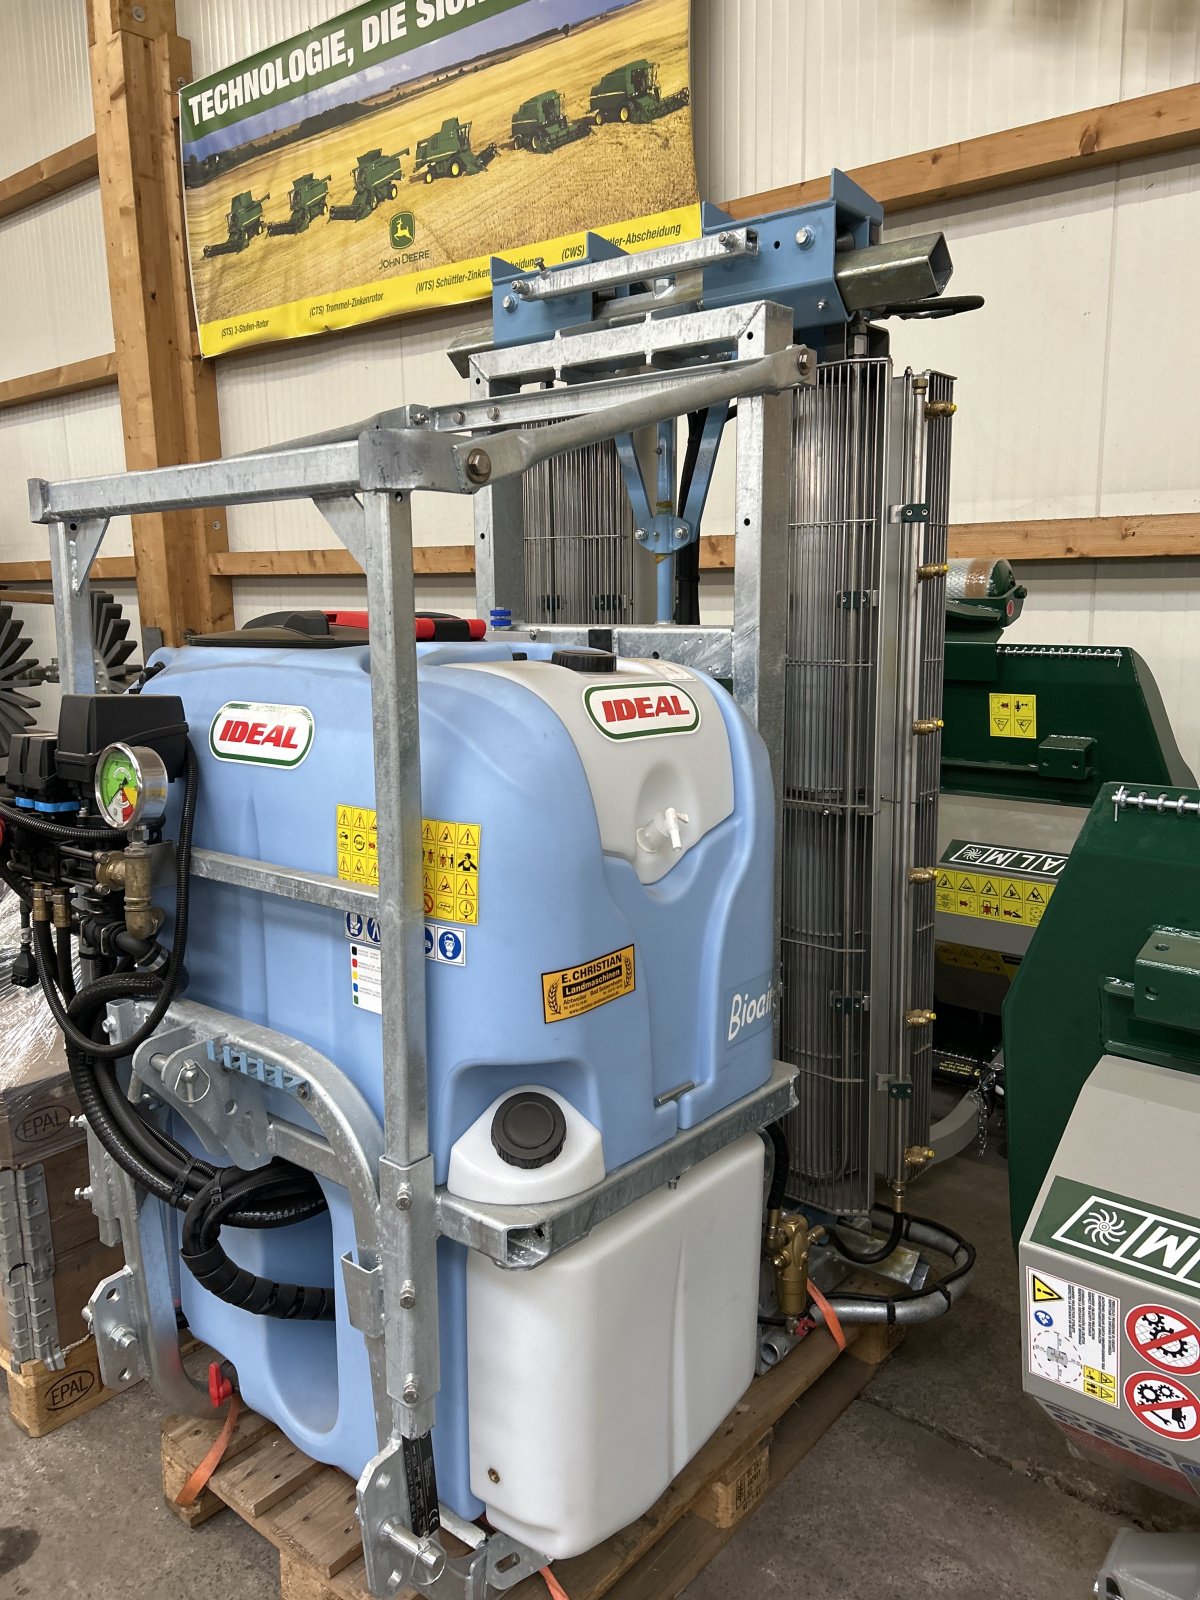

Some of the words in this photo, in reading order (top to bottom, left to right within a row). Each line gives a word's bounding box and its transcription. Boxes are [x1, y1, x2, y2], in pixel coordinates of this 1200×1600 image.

[188, 28, 354, 126] TECHNOLOGIE,
[361, 1, 407, 54] DIE
[378, 256, 401, 270] JOHN
[402, 249, 430, 265] DEERE
[561, 244, 585, 262] (CWS)
[415, 281, 435, 294] (WTS)
[309, 305, 324, 318] (CTS)
[325, 292, 385, 313] Trommel-Zinkenrotor
[221, 327, 234, 338] (STS)
[234, 318, 270, 334] 3-Stufen-Rotor
[602, 695, 690, 723] IDEAL
[219, 719, 299, 750] IDEAL
[561, 973, 571, 984] E.
[572, 953, 622, 981] CHRISTIAN
[565, 969, 620, 996] Landmaschinen
[22, 1109, 66, 1139] EPAL
[51, 1376, 88, 1407] EPAL
